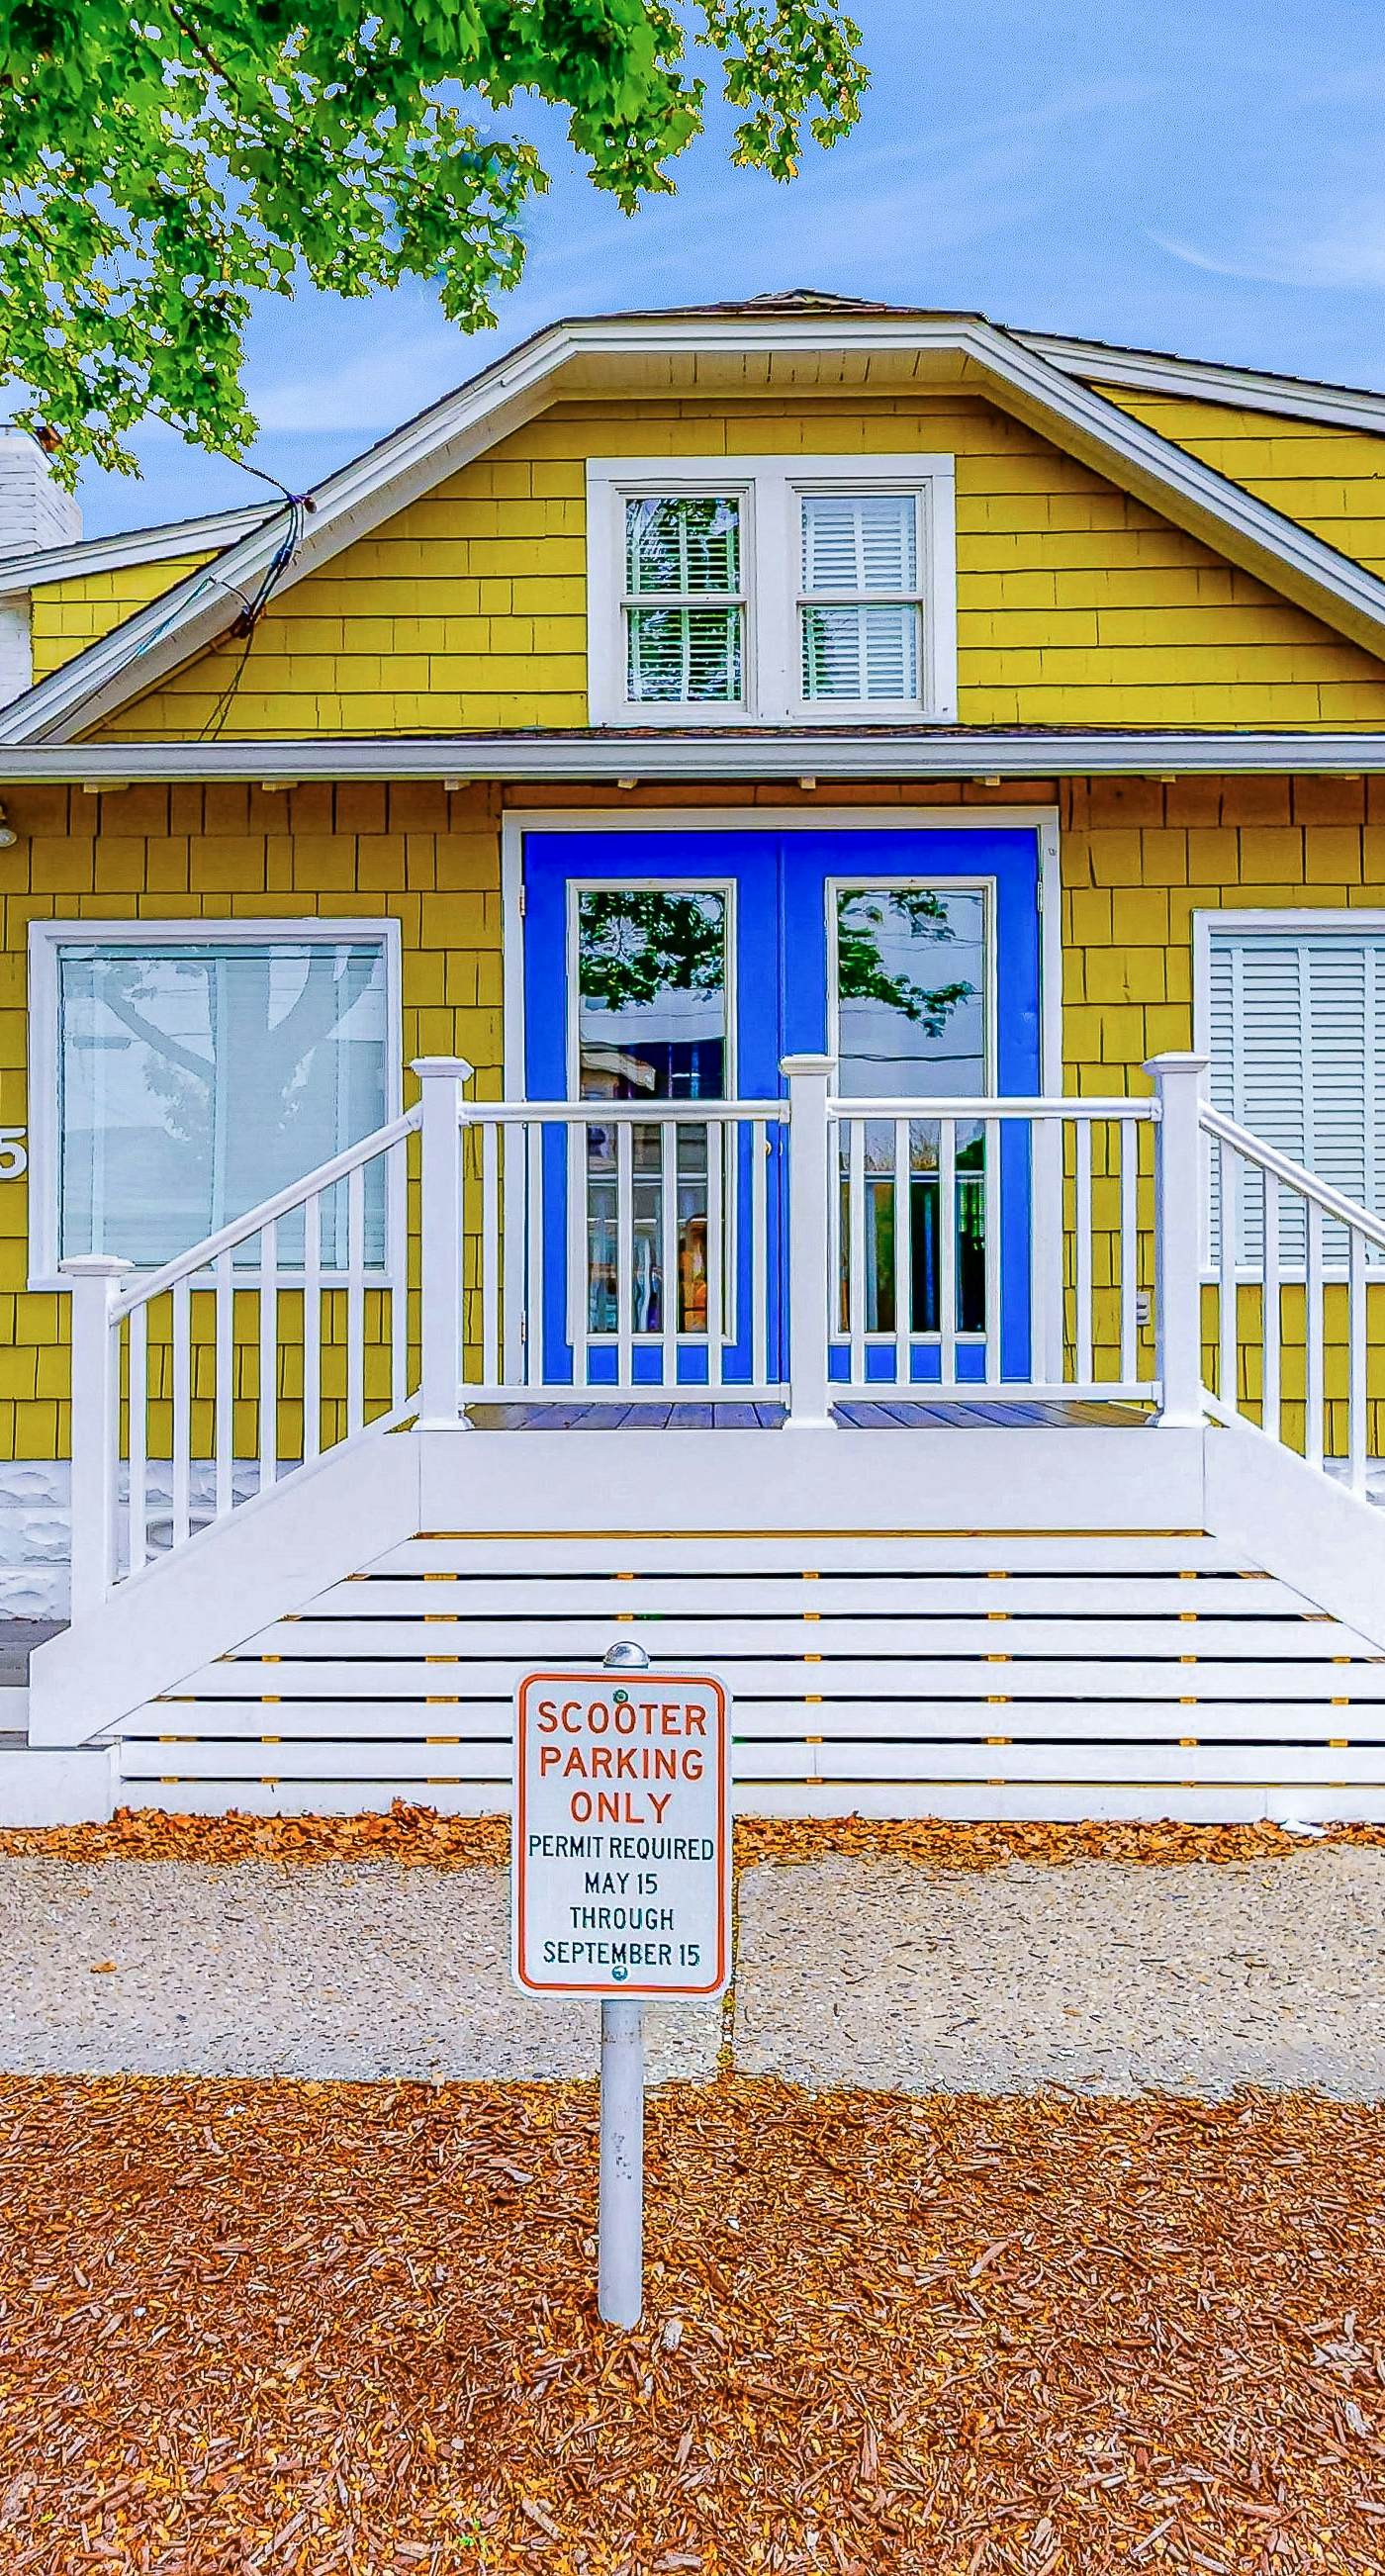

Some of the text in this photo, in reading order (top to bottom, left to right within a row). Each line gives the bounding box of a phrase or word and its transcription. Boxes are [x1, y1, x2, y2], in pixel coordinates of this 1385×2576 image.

[536, 1701, 707, 1736] SCOOTER
[539, 1746, 704, 1781] PARKING
[570, 1792, 673, 1824] ONLY
[528, 1835, 714, 1861] PERMIT REQUIRED
[585, 1873, 658, 1895] MAY 15
[570, 1907, 675, 1930] THROUGH
[544, 1942, 700, 1967] SEPTEMBER 15
